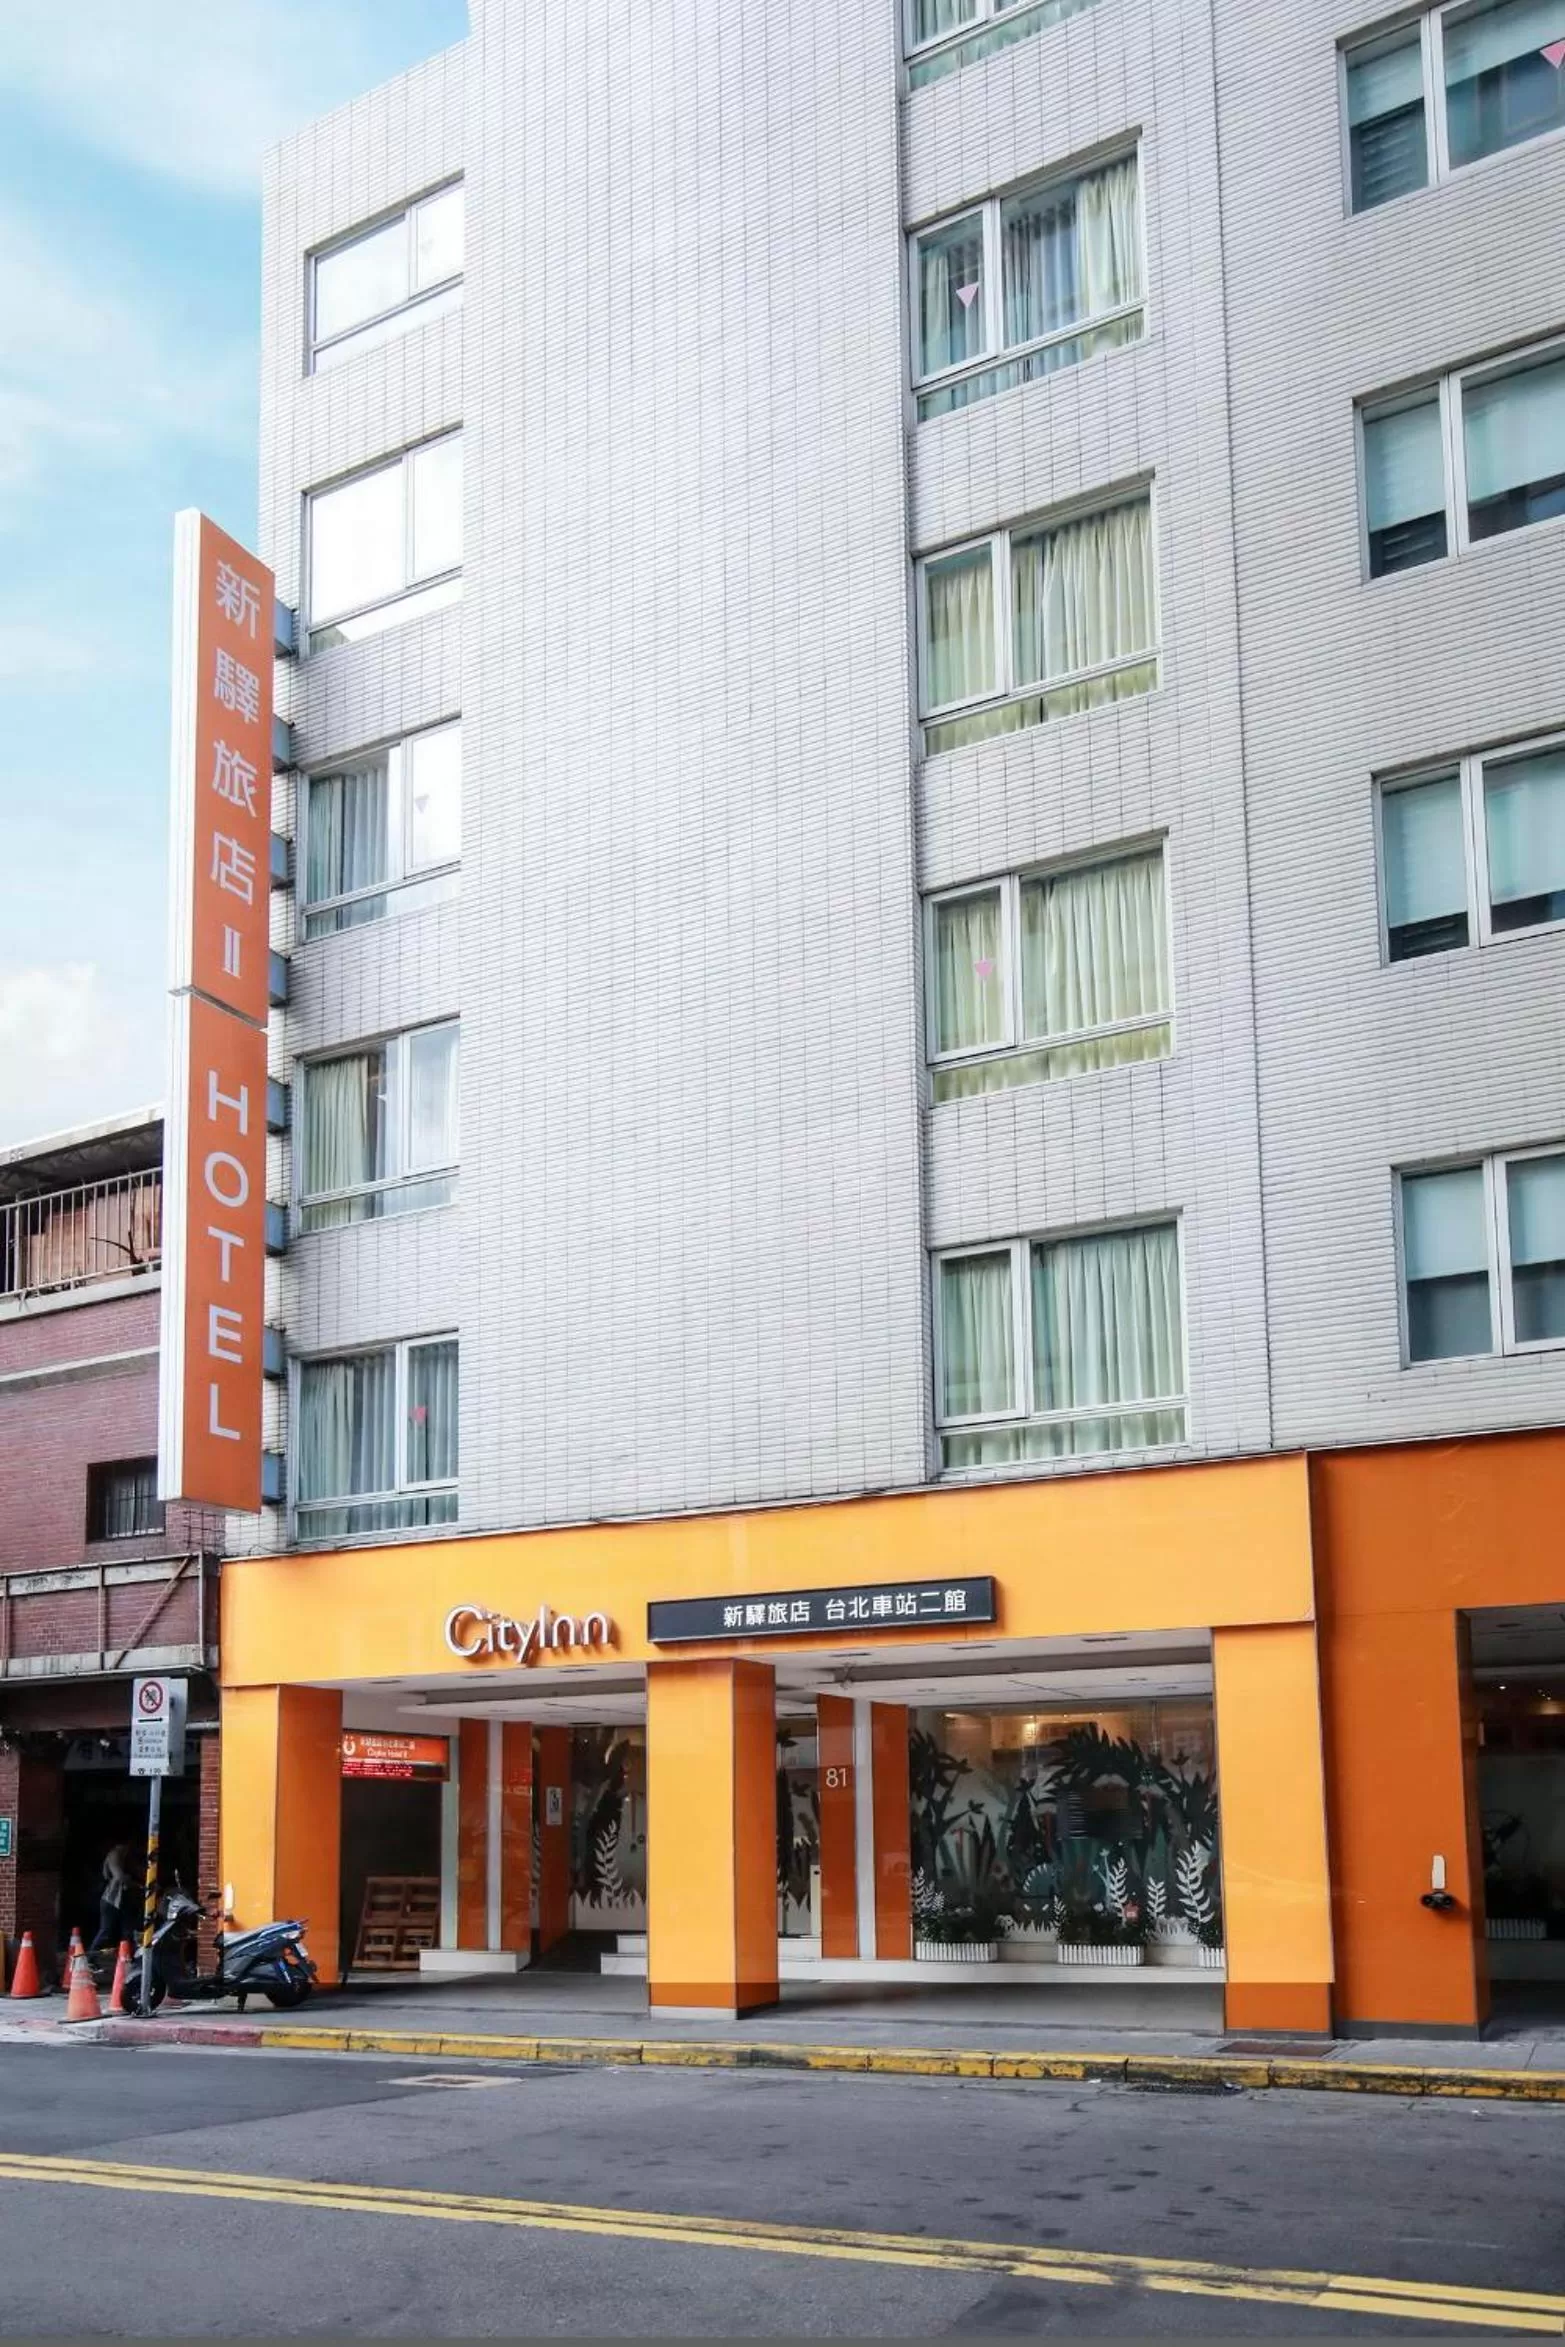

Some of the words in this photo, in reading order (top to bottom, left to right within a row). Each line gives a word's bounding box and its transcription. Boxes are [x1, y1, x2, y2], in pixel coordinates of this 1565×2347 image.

[203, 1069, 250, 1442] HOTEL
[723, 1599, 811, 1628] 新驛旅店
[825, 1588, 967, 1621] 台北車站二館
[445, 1604, 612, 1665] CityInn
[825, 1767, 847, 1788] 81
